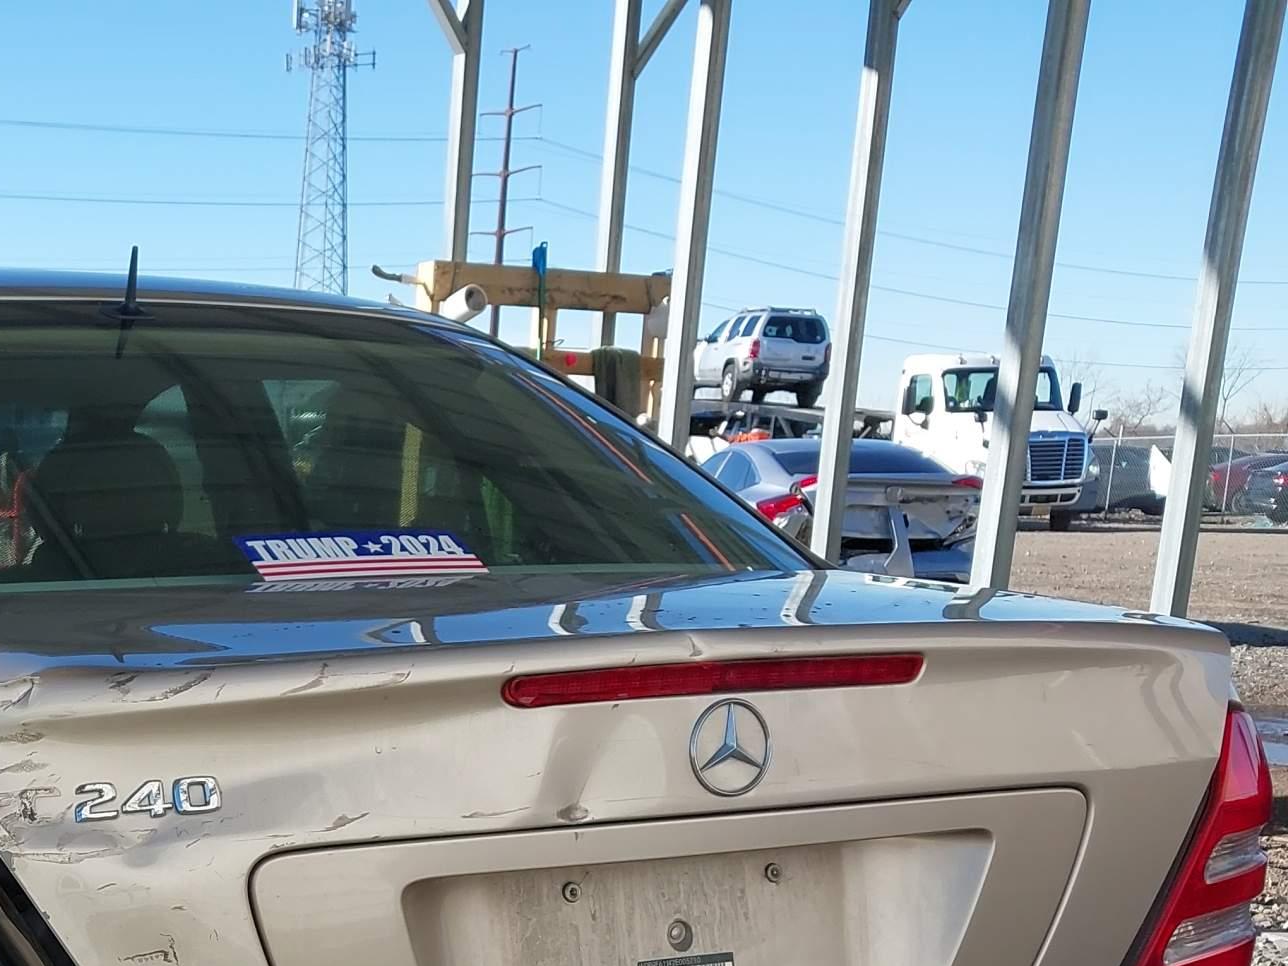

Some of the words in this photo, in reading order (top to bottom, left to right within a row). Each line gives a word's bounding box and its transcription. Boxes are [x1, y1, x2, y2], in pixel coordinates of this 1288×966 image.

[246, 536, 358, 562] TRUMP
[380, 534, 466, 557] 2024
[74, 776, 222, 824] 240
